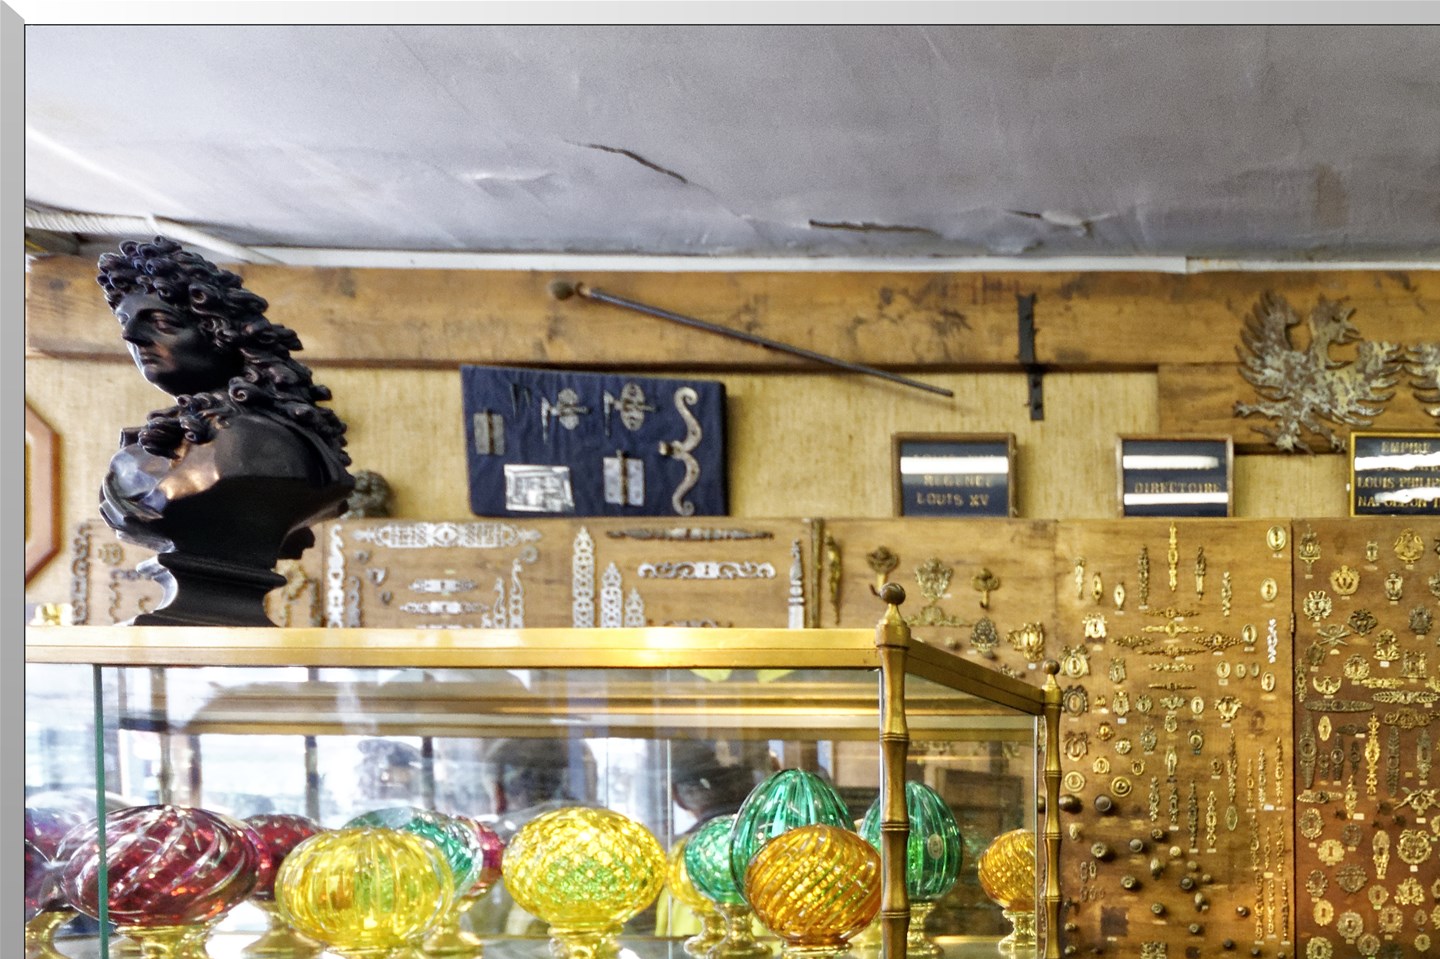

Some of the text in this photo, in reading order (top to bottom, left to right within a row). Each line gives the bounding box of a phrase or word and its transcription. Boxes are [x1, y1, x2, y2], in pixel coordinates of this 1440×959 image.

[1381, 442, 1430, 454] EMPIRE
[1134, 481, 1220, 493] DIRECTOIRE
[1357, 476, 1395, 489] LOUIS
[916, 493, 990, 507] LOUIS XV
